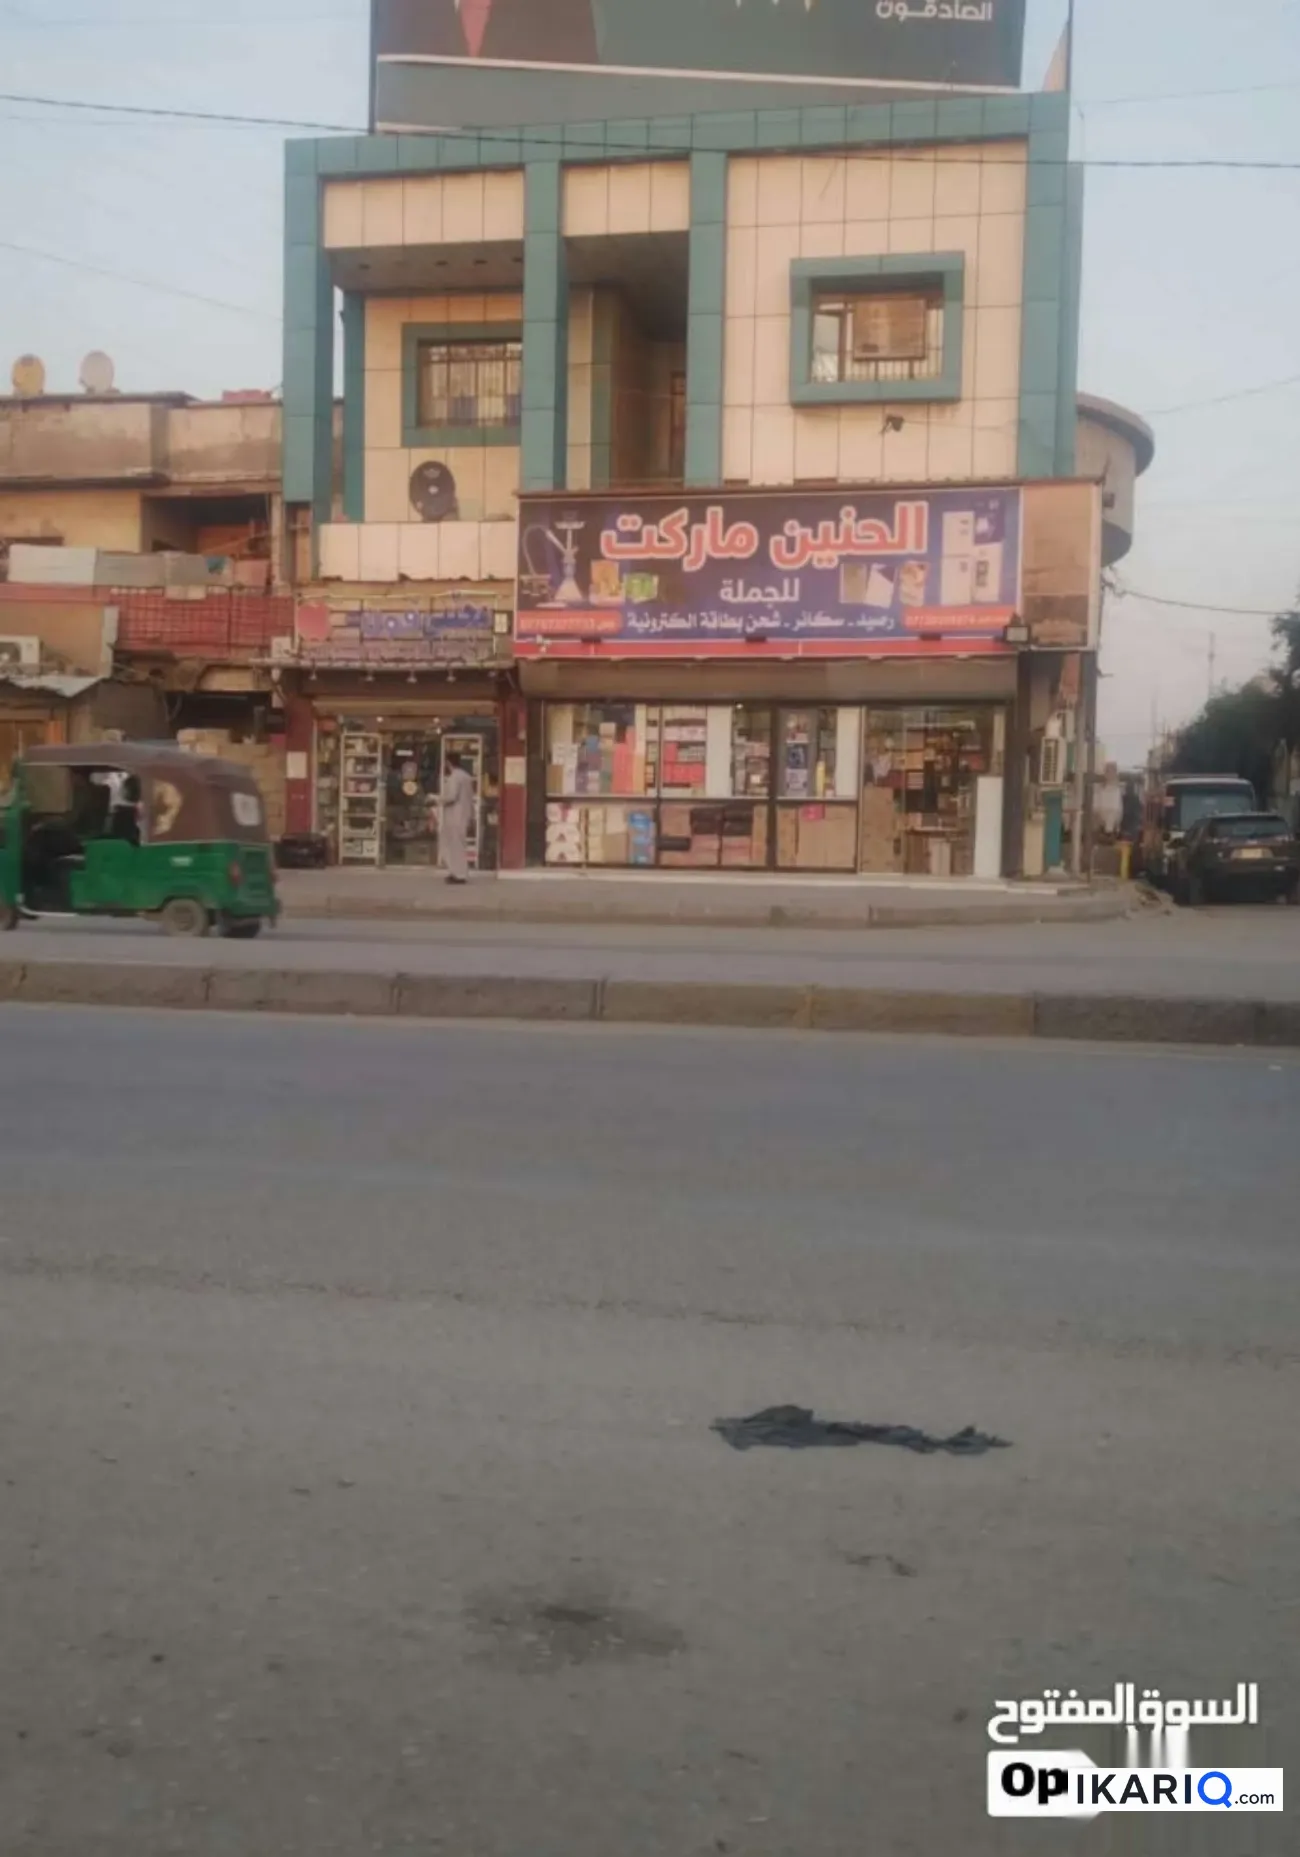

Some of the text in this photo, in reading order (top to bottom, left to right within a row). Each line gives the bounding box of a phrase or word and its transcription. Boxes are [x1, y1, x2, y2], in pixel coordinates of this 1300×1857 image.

[600, 501, 928, 571] الحنين ماركت
[720, 577, 799, 609] للجملة
[700, 610, 742, 633] بطاقة
[744, 609, 781, 634] شحن
[856, 612, 895, 632] رصيد
